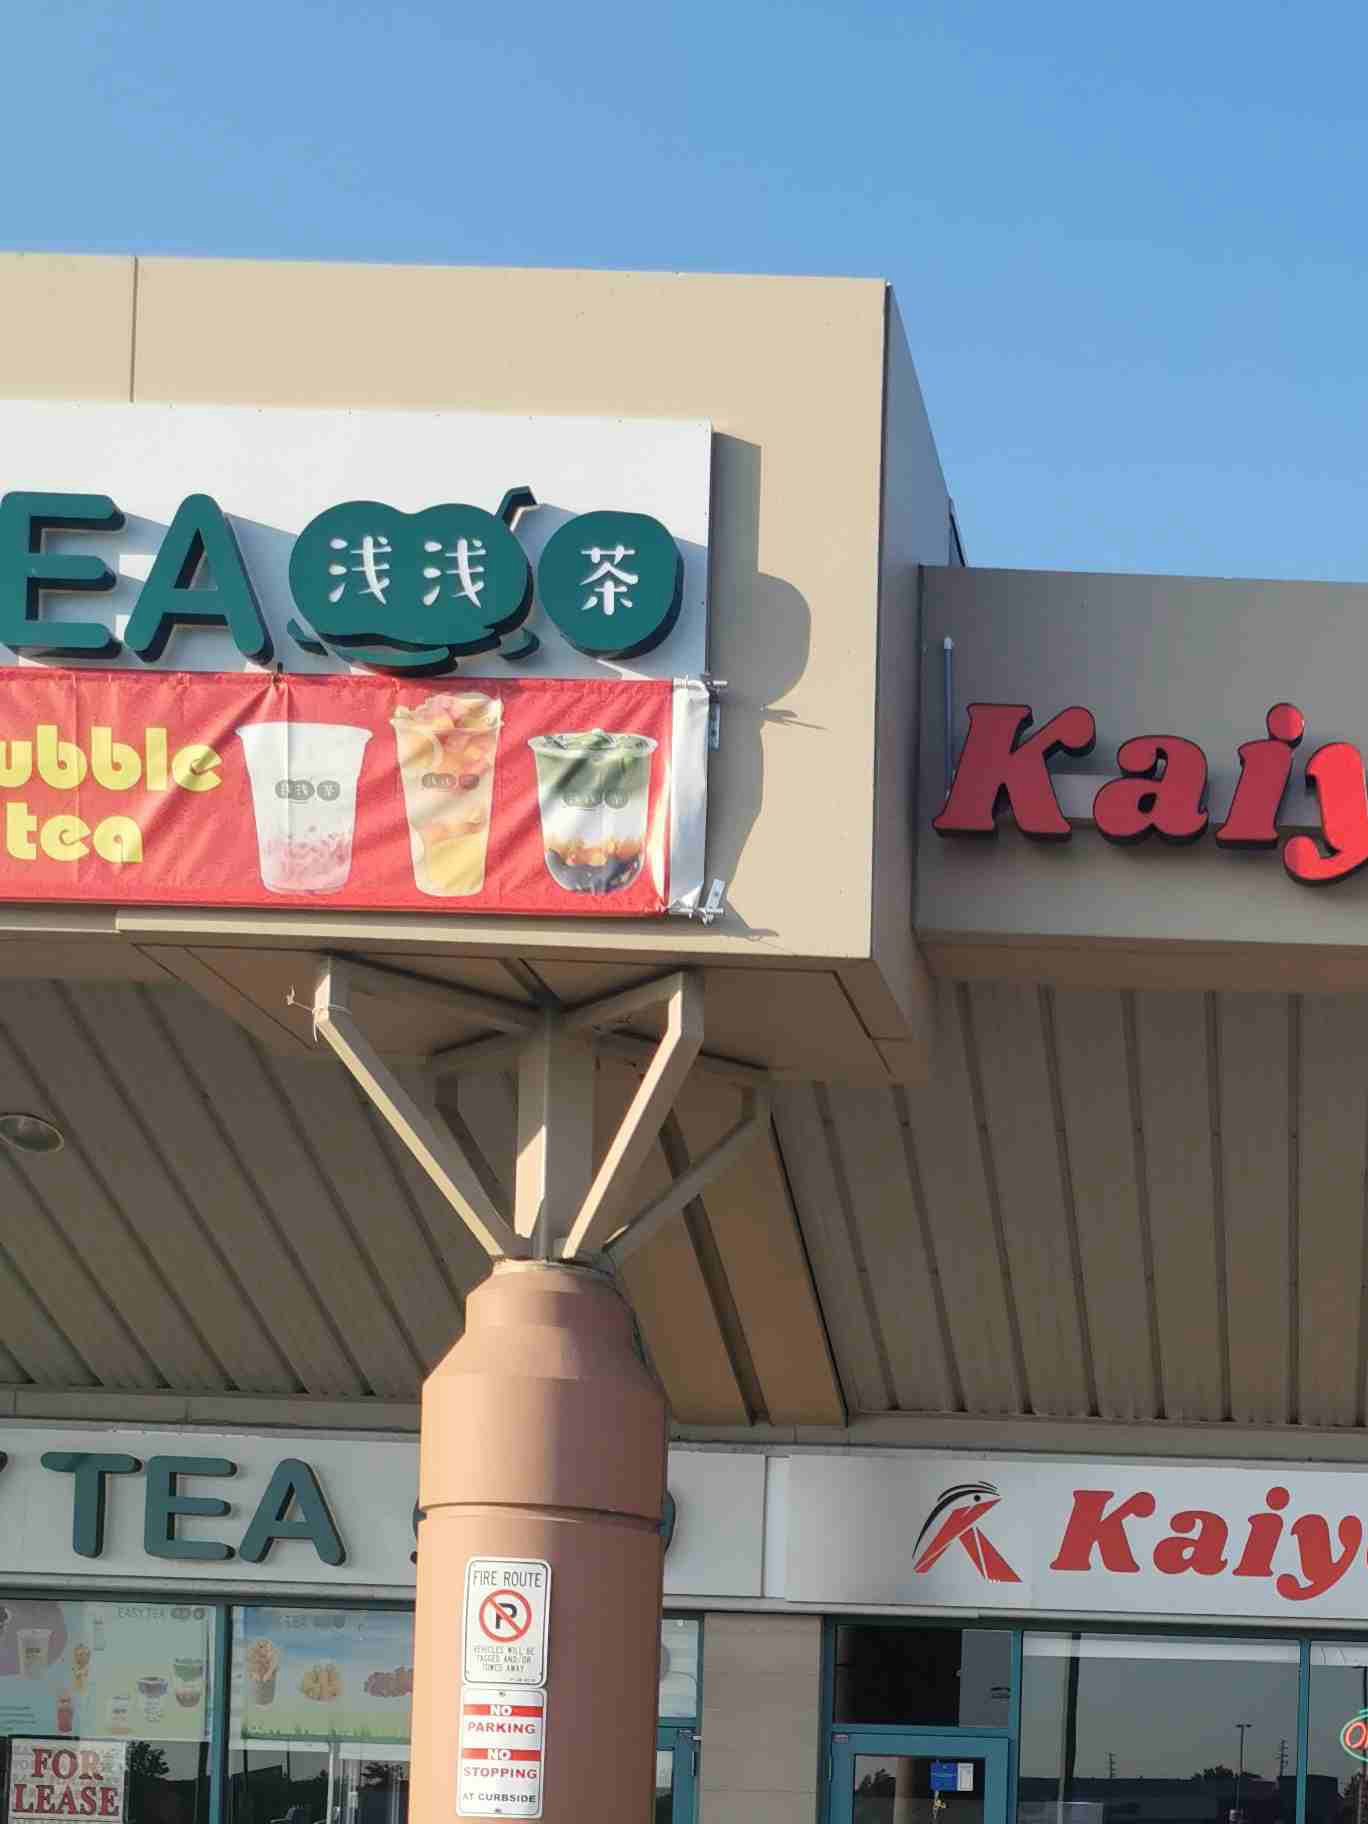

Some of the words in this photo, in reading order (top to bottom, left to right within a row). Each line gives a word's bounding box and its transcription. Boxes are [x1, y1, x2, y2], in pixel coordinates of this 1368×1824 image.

[0, 491, 274, 665] EA
[0, 724, 223, 792] ubble
[6, 801, 144, 864] tea
[40, 1451, 347, 1566] TEA
[472, 1569, 497, 1586] FIRE
[503, 1570, 543, 1588] ROUTE
[489, 1704, 512, 1717] NO
[467, 1721, 536, 1734] PARKING
[31, 1748, 104, 1781] FOR
[487, 1748, 513, 1761] NO
[463, 1766, 538, 1780] STOPPING
[12, 1783, 120, 1817] LEASE
[462, 1792, 475, 1801] AT
[477, 1793, 537, 1803] CURBSIDE
